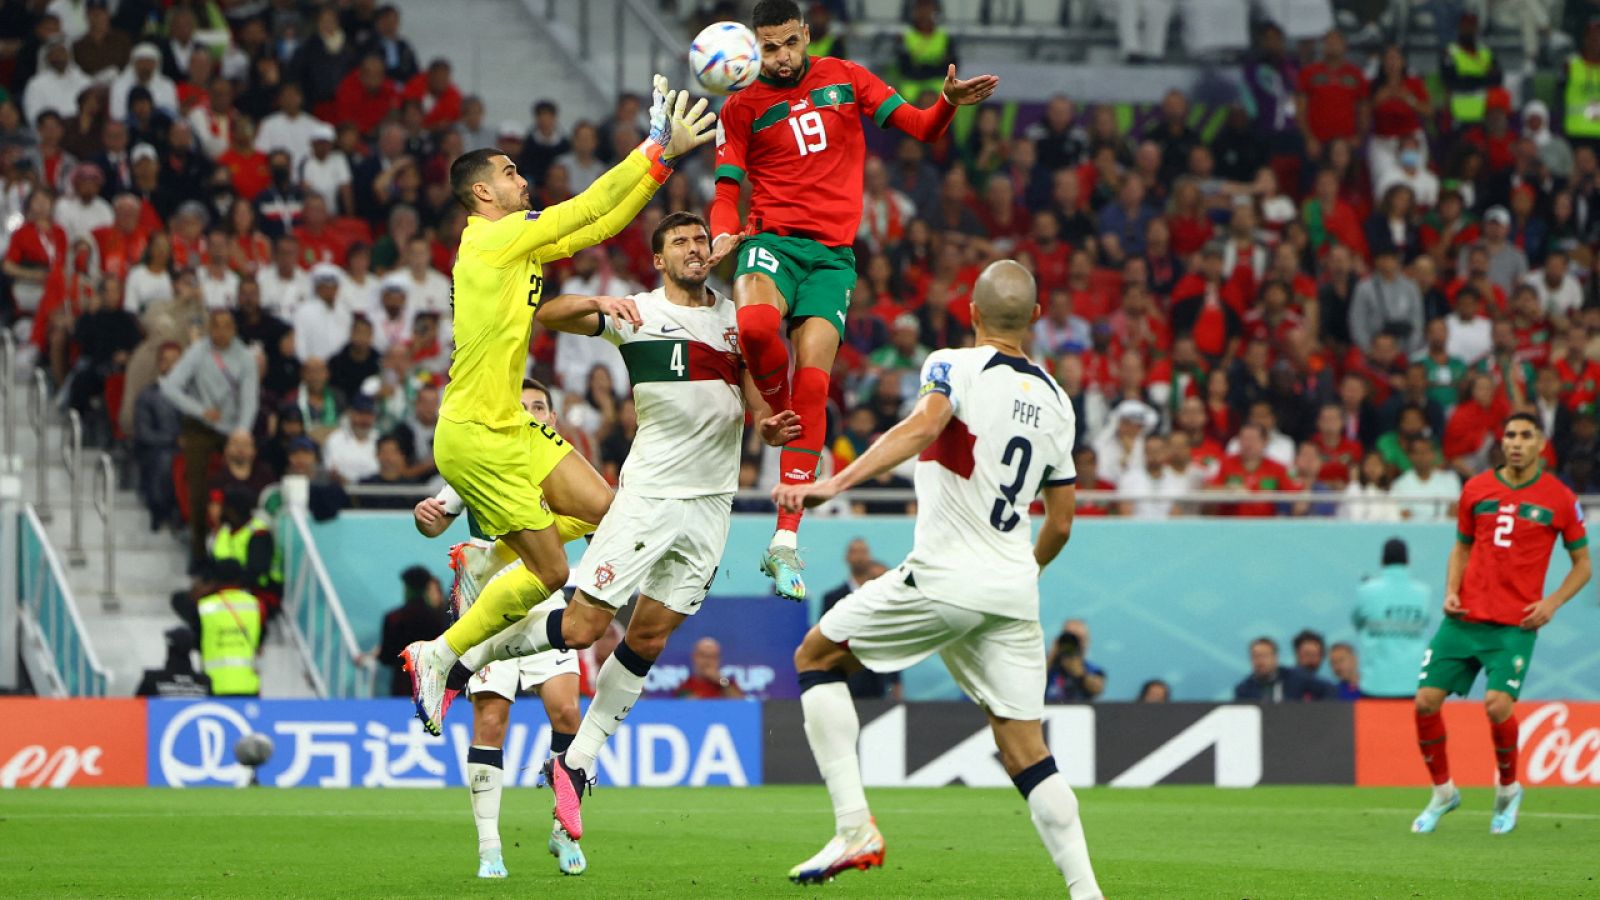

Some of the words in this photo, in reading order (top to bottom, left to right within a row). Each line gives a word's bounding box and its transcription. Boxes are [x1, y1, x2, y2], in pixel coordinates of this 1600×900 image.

[788, 111, 828, 156] 19
[527, 274, 543, 307] 2
[669, 343, 685, 377] 4
[1012, 399, 1042, 429] PEPE
[990, 435, 1033, 532] 3
[1493, 515, 1514, 548] 2
[273, 719, 447, 788] 万达
[1518, 702, 1600, 784] Coc
